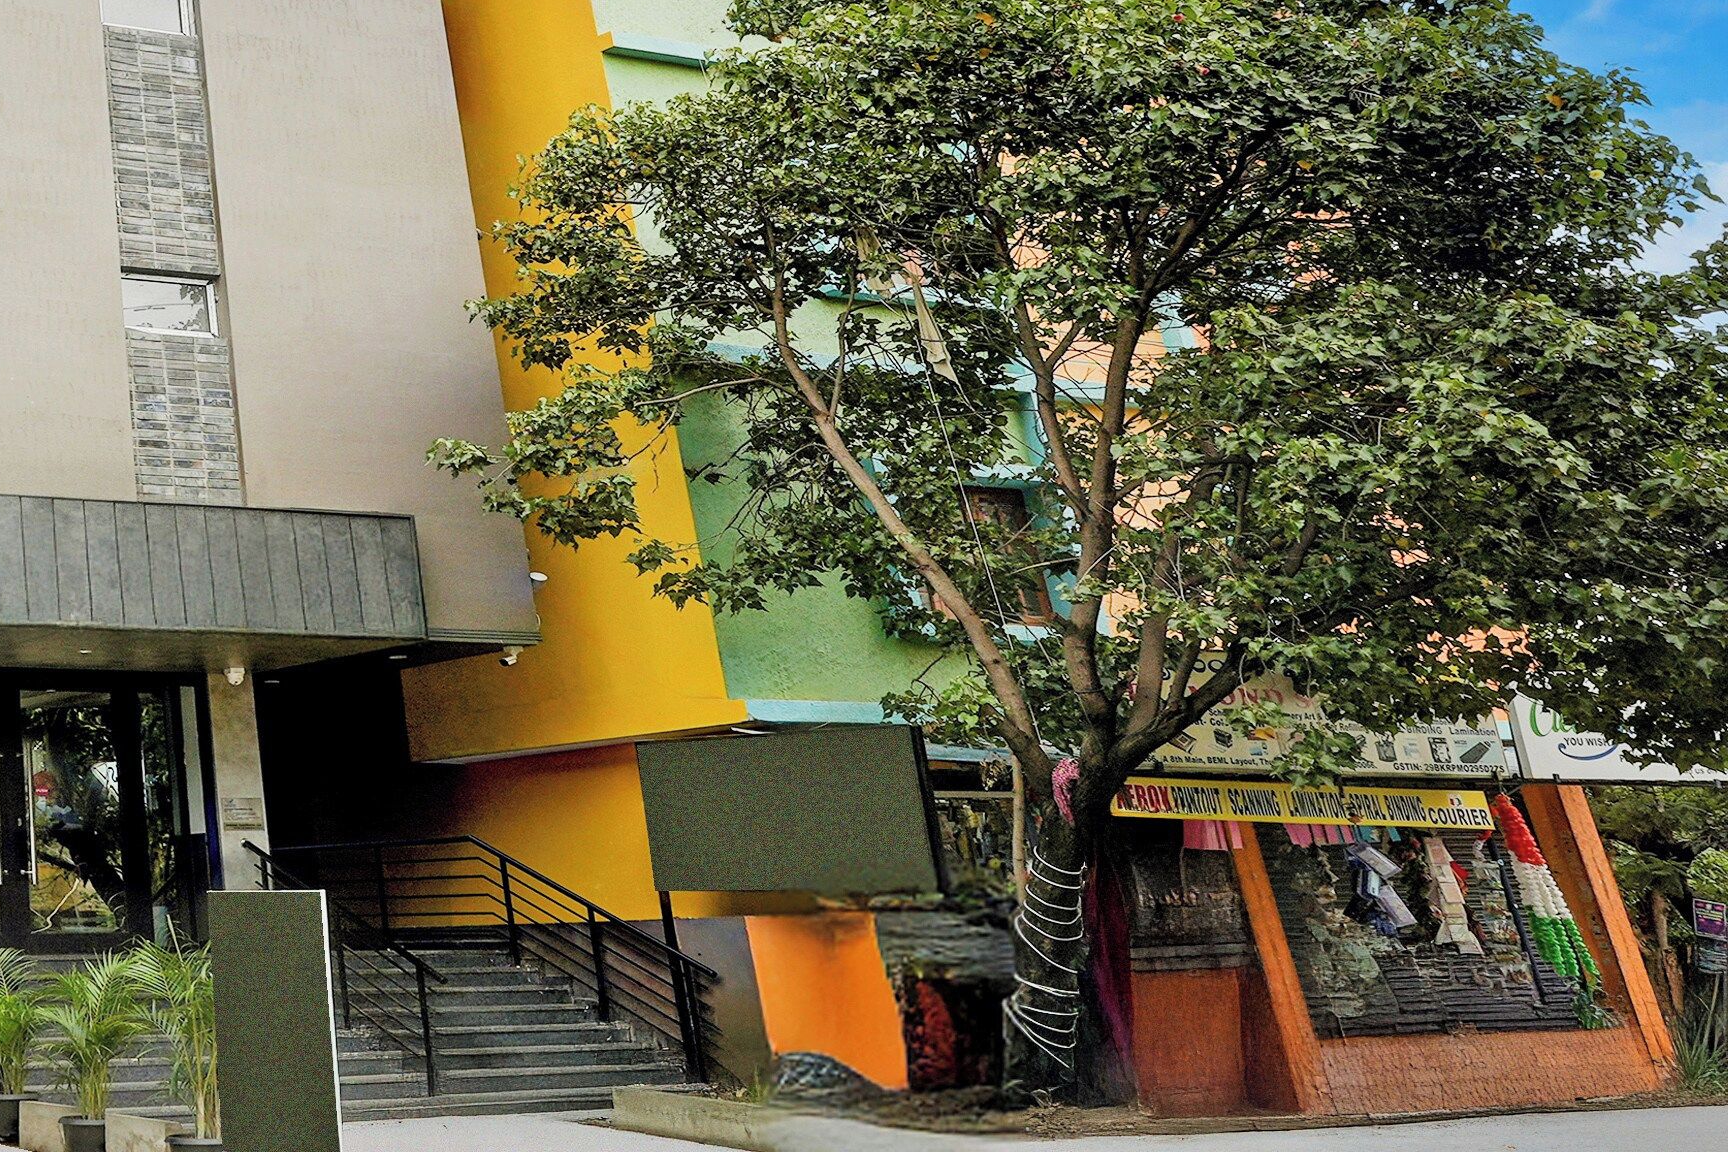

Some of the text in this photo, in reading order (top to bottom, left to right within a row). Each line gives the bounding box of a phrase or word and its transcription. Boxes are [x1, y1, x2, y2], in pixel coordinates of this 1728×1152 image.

[1449, 727, 1496, 736] Lamination
[1563, 737, 1584, 746] YOU
[1227, 788, 1281, 817] SCANNING
[1428, 807, 1491, 826] COURIER
